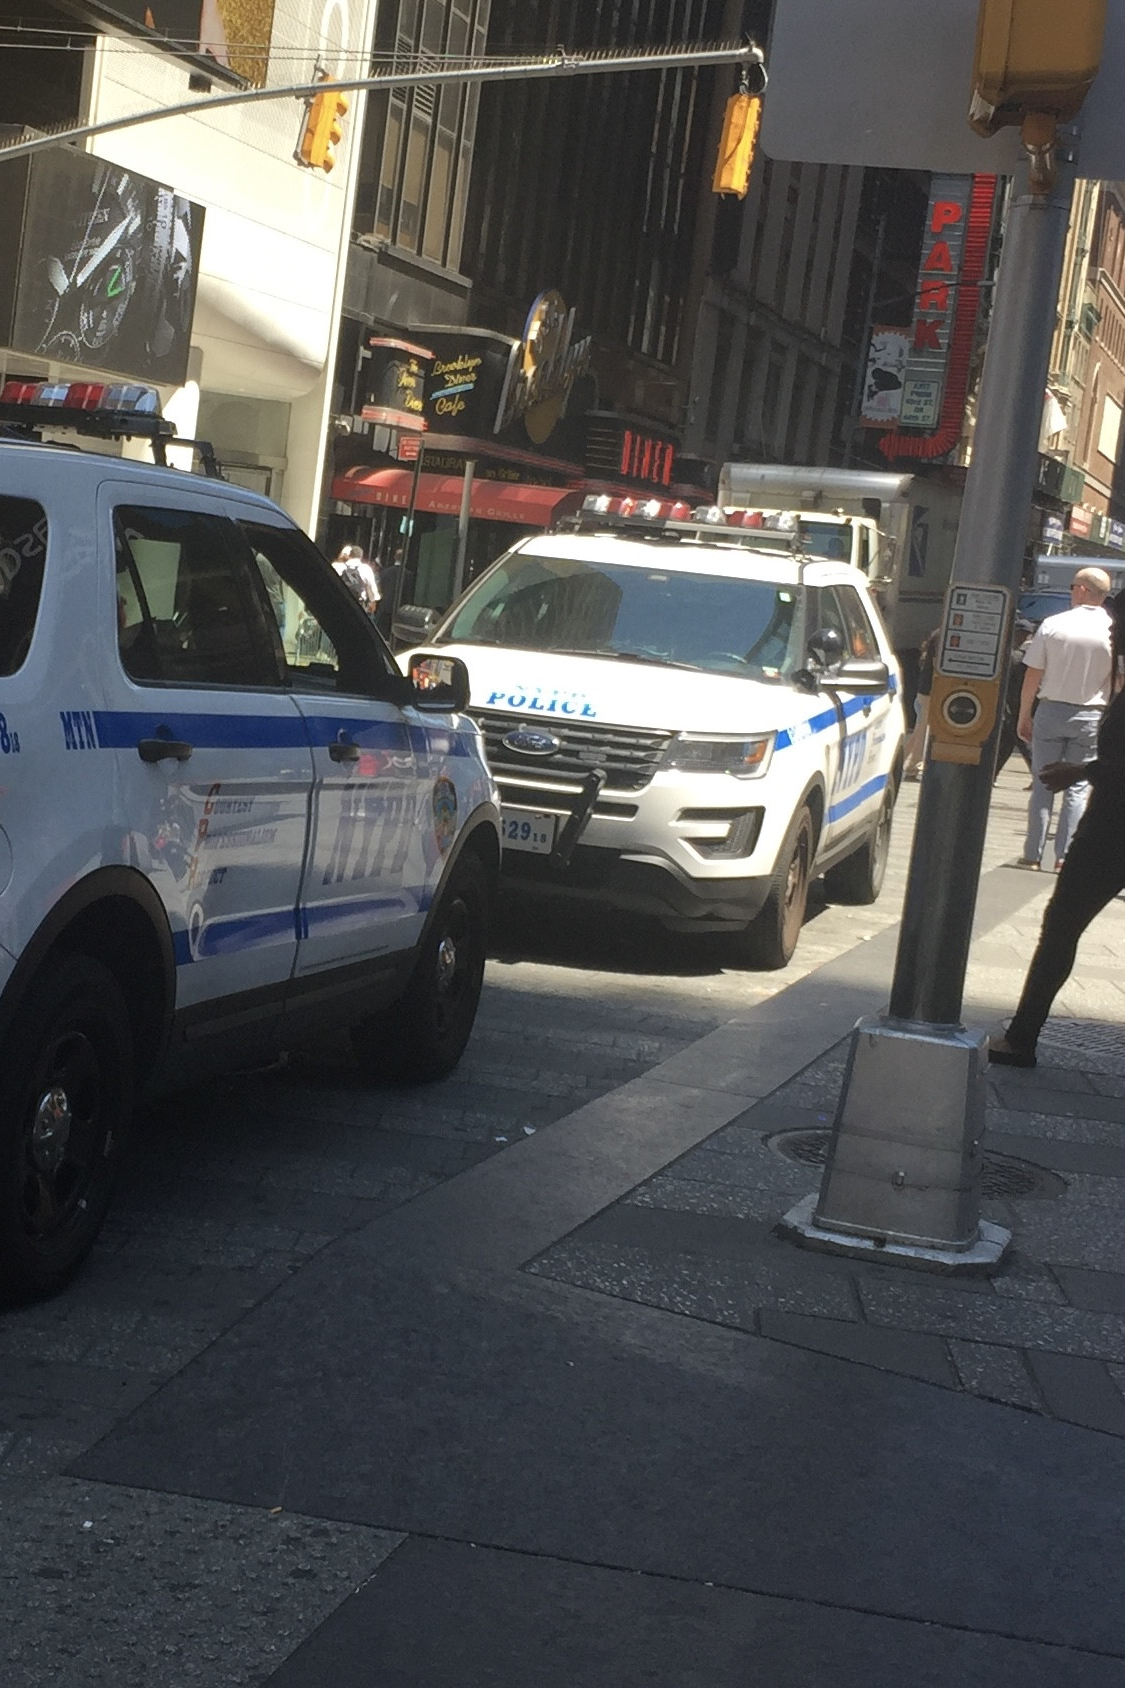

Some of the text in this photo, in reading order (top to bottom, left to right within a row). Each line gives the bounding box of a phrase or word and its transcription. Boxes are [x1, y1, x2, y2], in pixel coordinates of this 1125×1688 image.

[914, 201, 963, 350] PARK
[430, 354, 482, 376] Brooklyn
[435, 394, 466, 416] Cafe
[486, 691, 597, 718] POLICE
[60, 711, 96, 750] MTN
